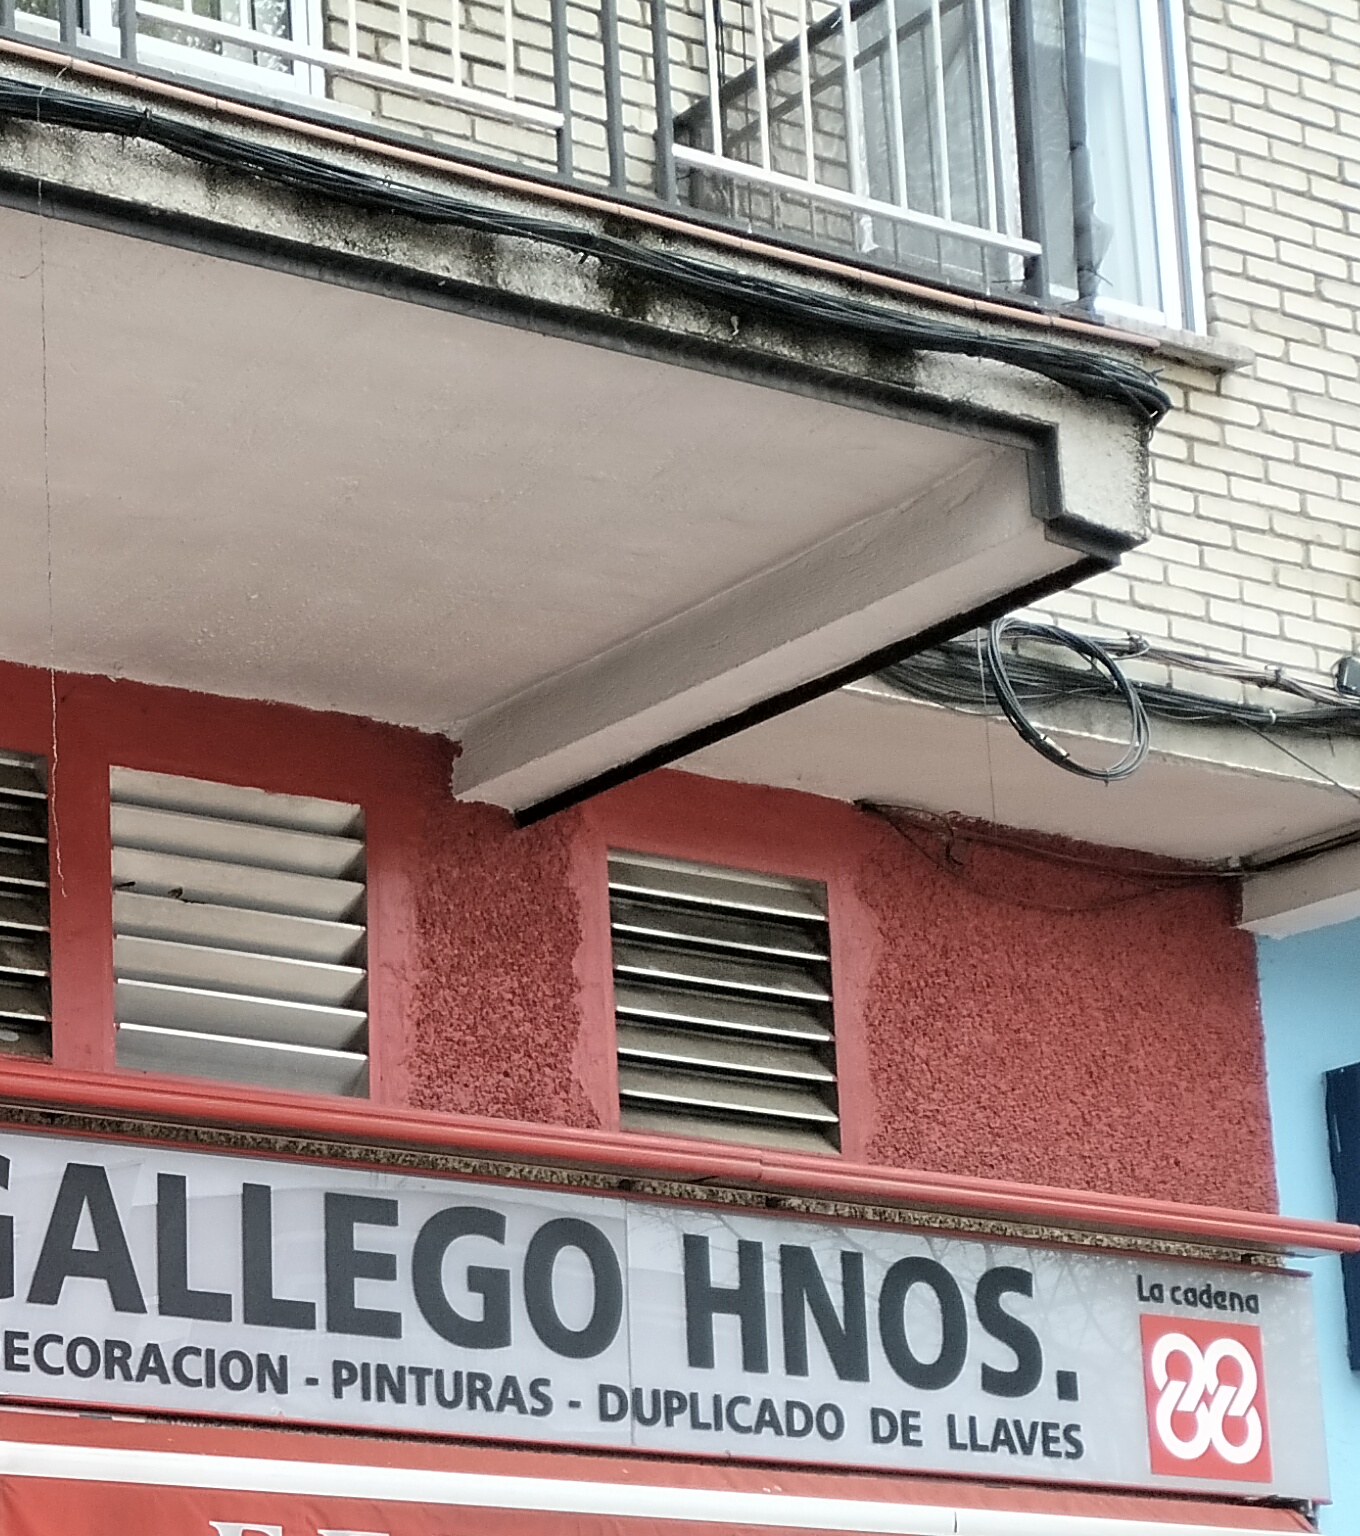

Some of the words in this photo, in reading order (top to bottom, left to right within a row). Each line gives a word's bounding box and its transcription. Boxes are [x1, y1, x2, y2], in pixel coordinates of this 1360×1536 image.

[683, 1234, 1079, 1402] HNOS.
[1137, 1273, 1163, 1304] La
[1170, 1283, 1260, 1315] cadena
[333, 1359, 553, 1417] PINTURAS
[599, 1383, 845, 1442] DUPLICADO
[870, 1410, 922, 1447] DE
[947, 1414, 1084, 1461] LLAVES
